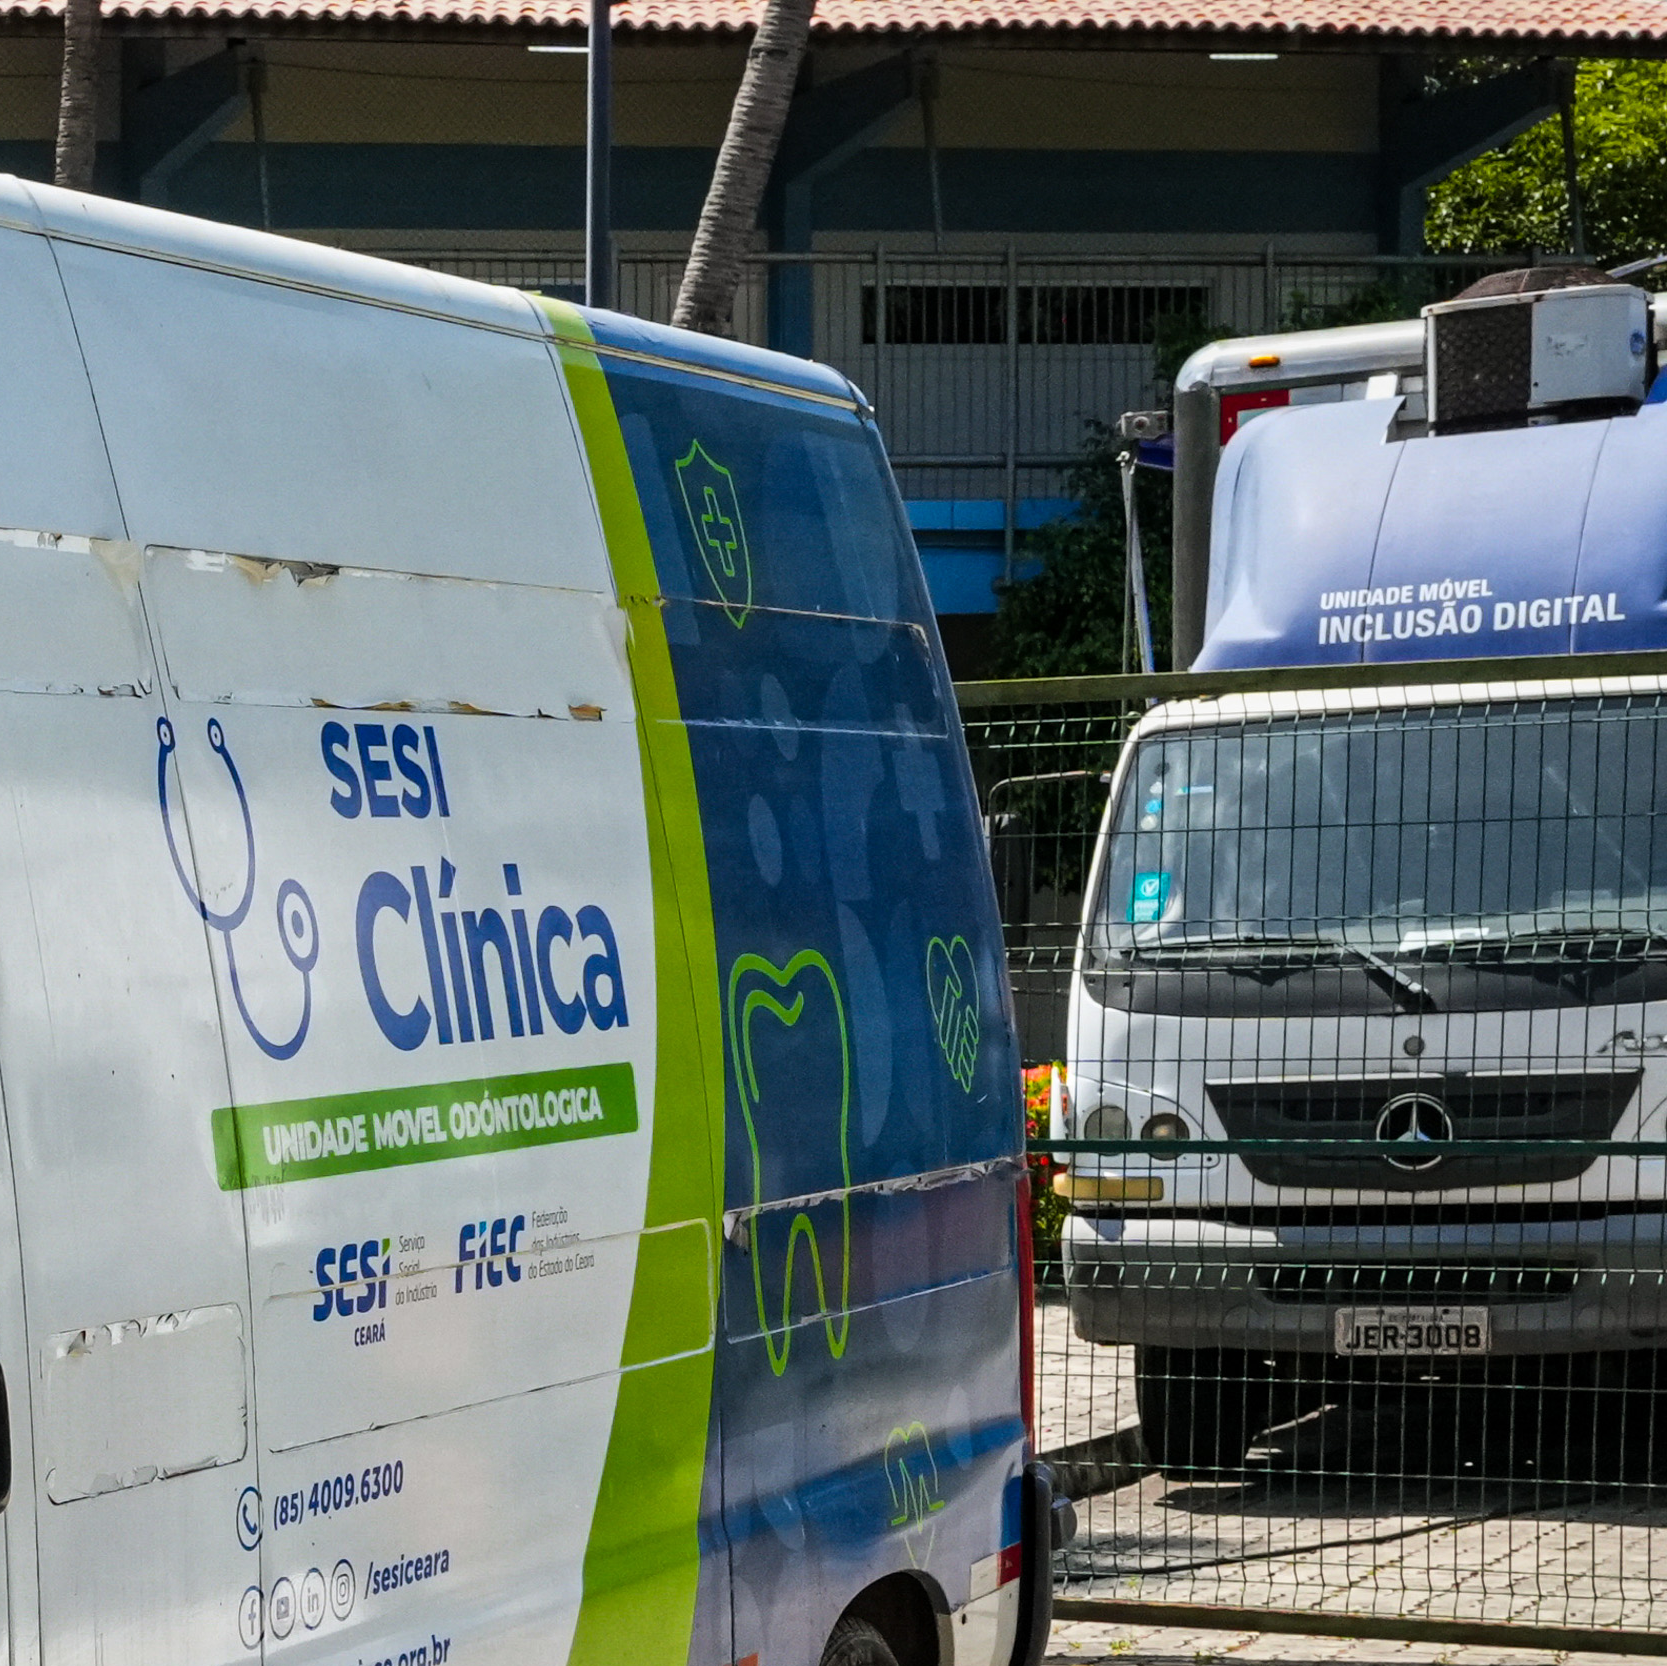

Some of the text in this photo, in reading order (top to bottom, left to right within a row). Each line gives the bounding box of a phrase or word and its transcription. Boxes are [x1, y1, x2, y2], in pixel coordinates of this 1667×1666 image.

[1318, 593, 1626, 645] INCLUSÃO DIGITAL
[1320, 578, 1493, 610] UNIDADE MÓVEL
[320, 721, 450, 819] SESI
[355, 856, 629, 1051] Clínica
[263, 1086, 604, 1165] UNIDADE MOVEL ODÓNTOLOGICA
[399, 1233, 426, 1253] Serviço
[455, 1215, 525, 1294] FIEC
[313, 1238, 390, 1322] SESI
[354, 1318, 386, 1347] CEARÁ
[273, 1460, 405, 1530] (85) 4009.6300
[364, 1549, 450, 1600] /sesiceara
